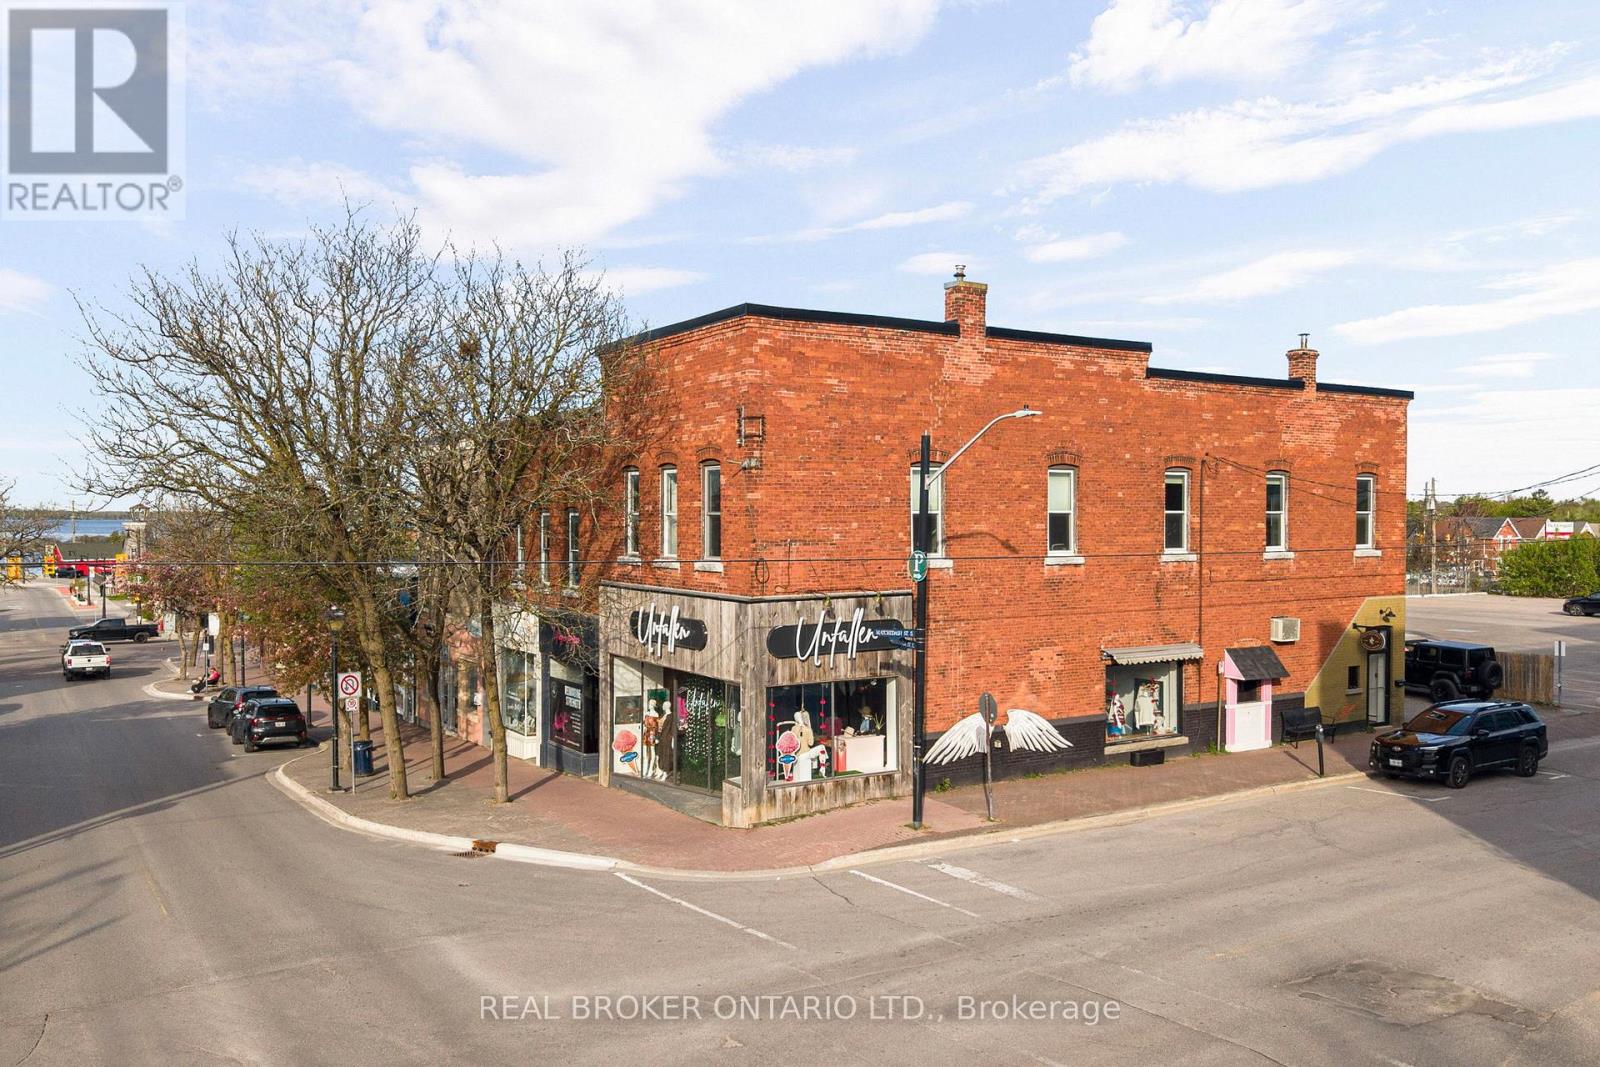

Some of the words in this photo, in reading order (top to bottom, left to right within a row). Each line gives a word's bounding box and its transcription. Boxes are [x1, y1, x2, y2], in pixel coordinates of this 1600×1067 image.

[914, 553, 924, 571] P
[638, 602, 690, 657] Unfallen
[796, 607, 879, 669] Unfallen
